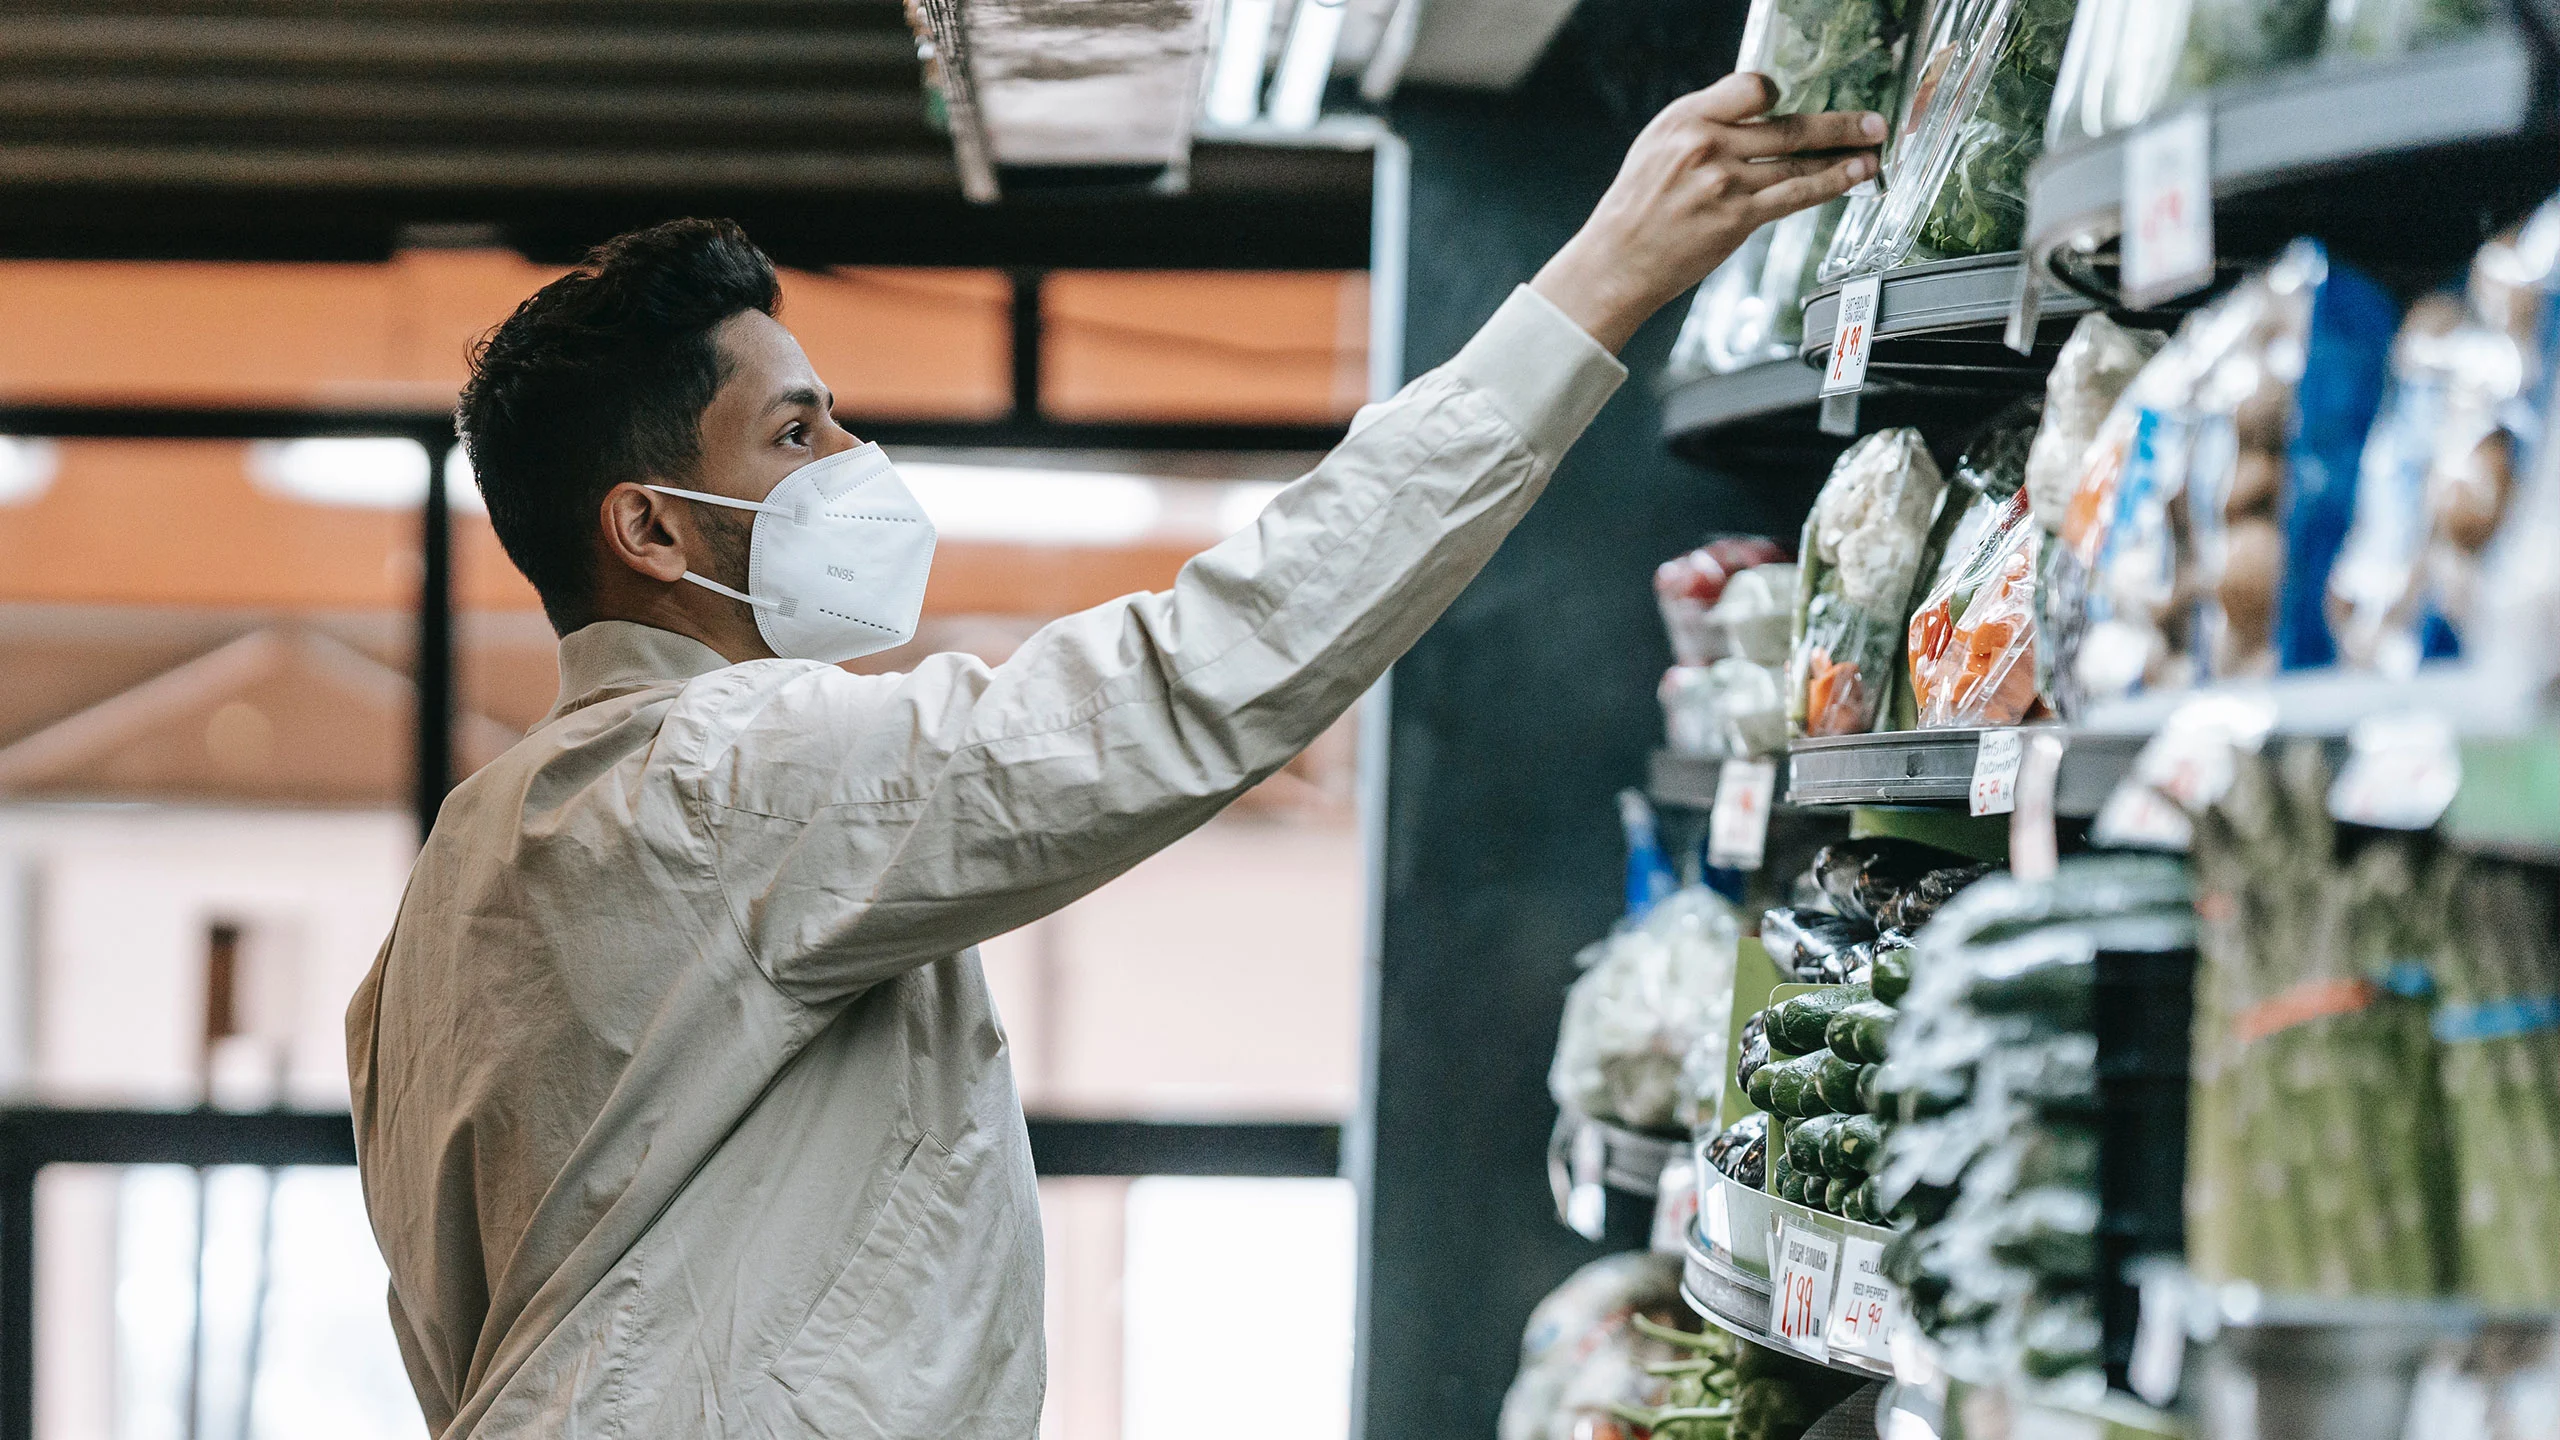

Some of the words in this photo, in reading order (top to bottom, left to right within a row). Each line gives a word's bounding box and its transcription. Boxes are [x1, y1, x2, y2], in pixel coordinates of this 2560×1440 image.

[826, 565, 855, 582] KN95
[1859, 1260, 1885, 1277] HOLLAN
[1853, 1281, 1864, 1296] RED
[1866, 1285, 1888, 1301] PEPPER
